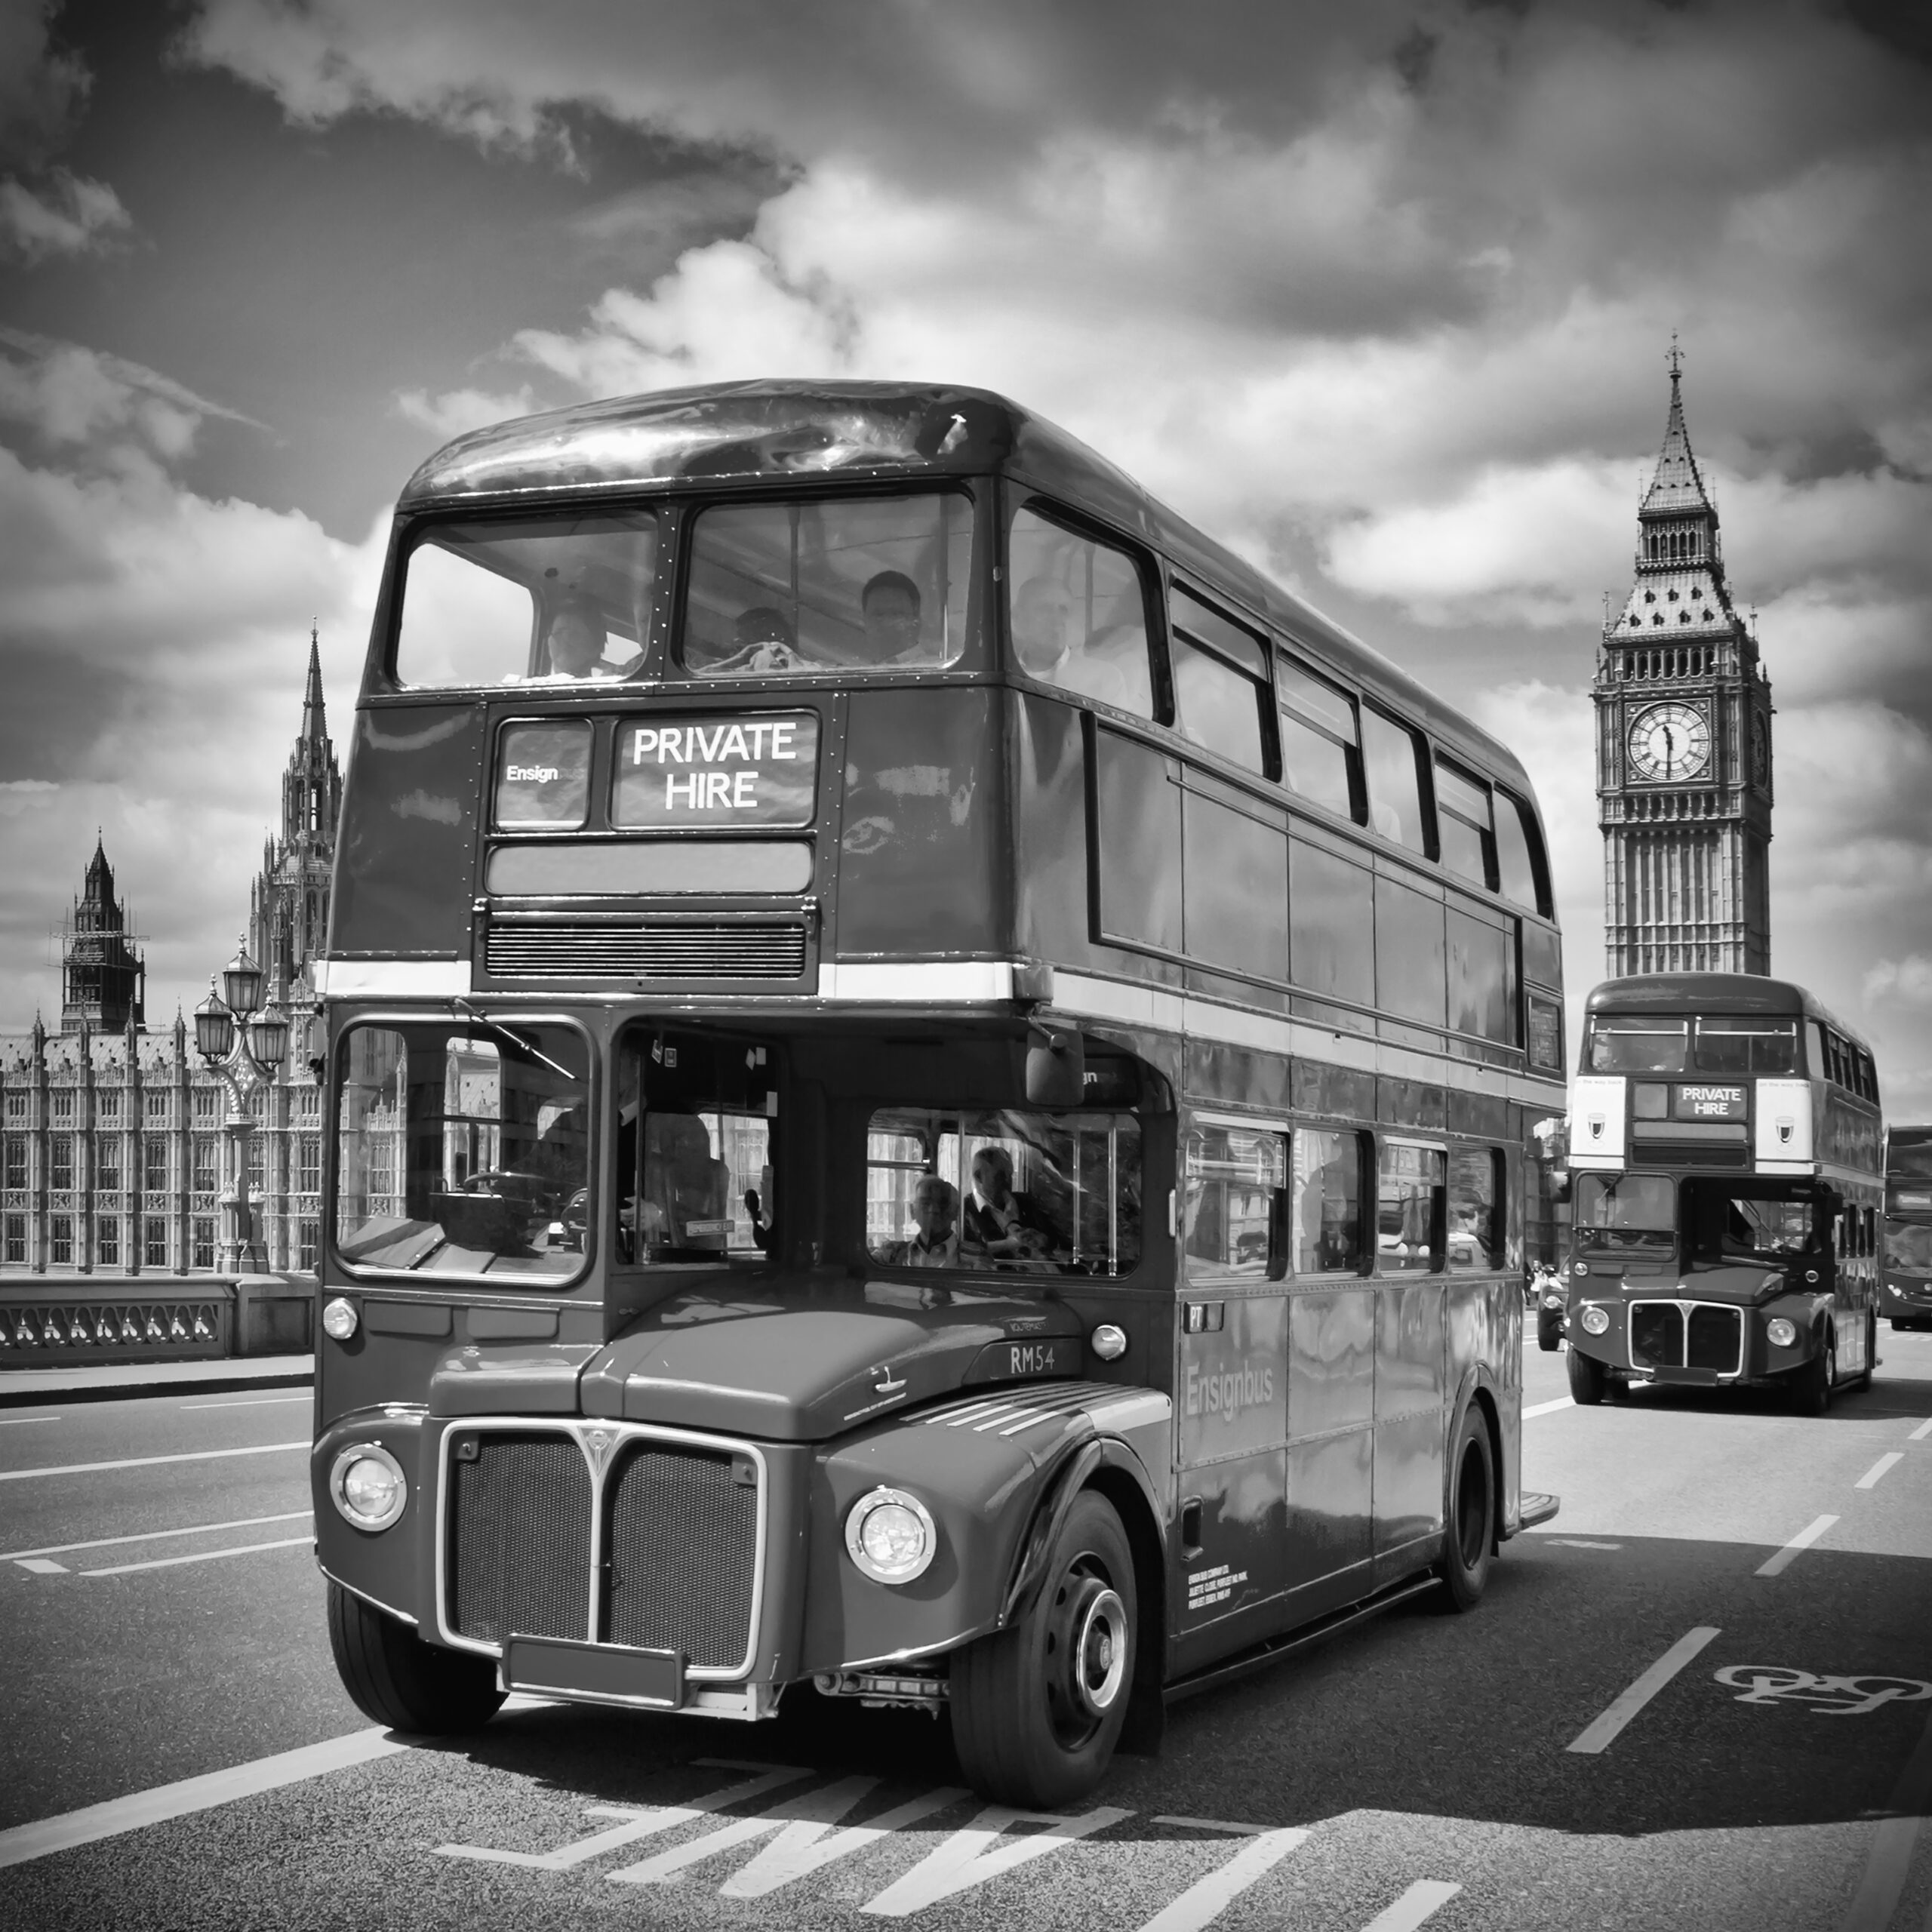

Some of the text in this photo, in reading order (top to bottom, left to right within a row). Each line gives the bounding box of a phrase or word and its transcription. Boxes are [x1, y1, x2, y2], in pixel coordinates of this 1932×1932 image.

[634, 722, 798, 765] PRIVATE
[665, 771, 759, 811] HIRE
[1682, 1087, 1742, 1102] PRIVATE
[1694, 1102, 1729, 1115] HIRE
[1011, 1346, 1055, 1374] RM54
[1186, 1359, 1273, 1422] Ensignbus
